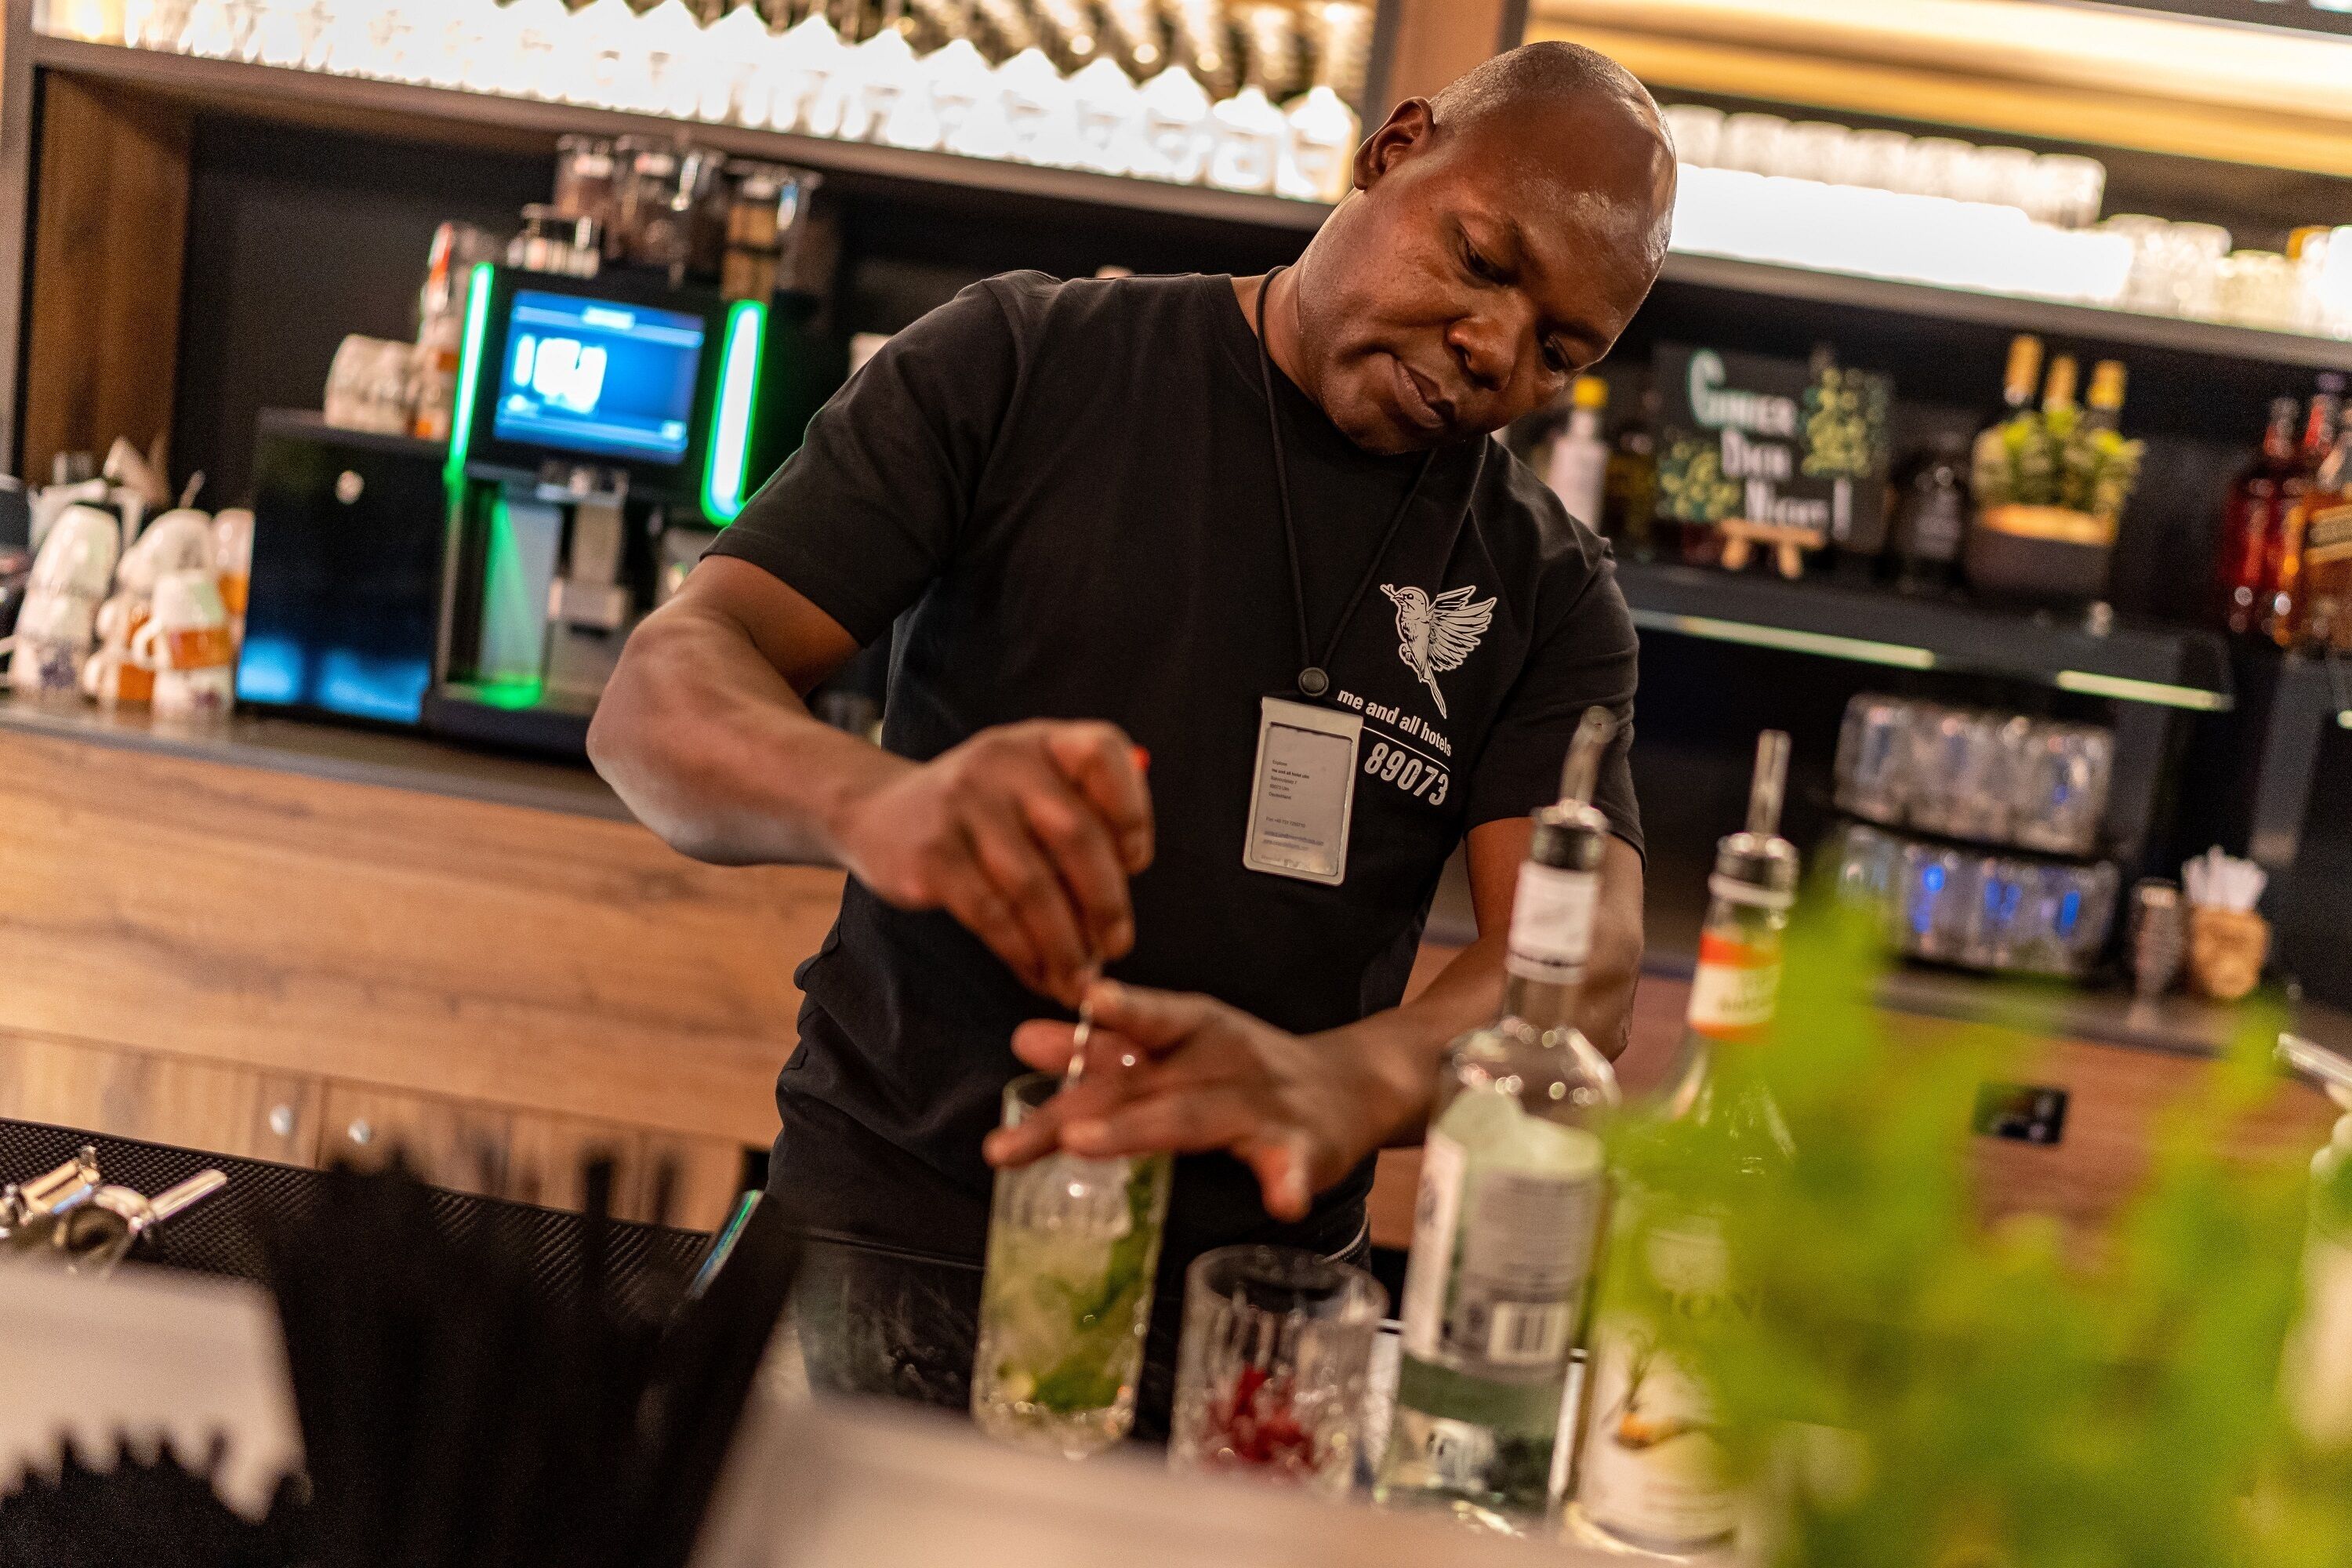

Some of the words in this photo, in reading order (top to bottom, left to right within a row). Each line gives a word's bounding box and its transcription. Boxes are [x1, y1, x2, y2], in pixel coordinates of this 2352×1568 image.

[1337, 690, 1363, 710] me
[1365, 702, 1400, 724] and
[1399, 715, 1421, 735] all
[1420, 721, 1451, 757] hotels
[1364, 742, 1449, 806] 89073
